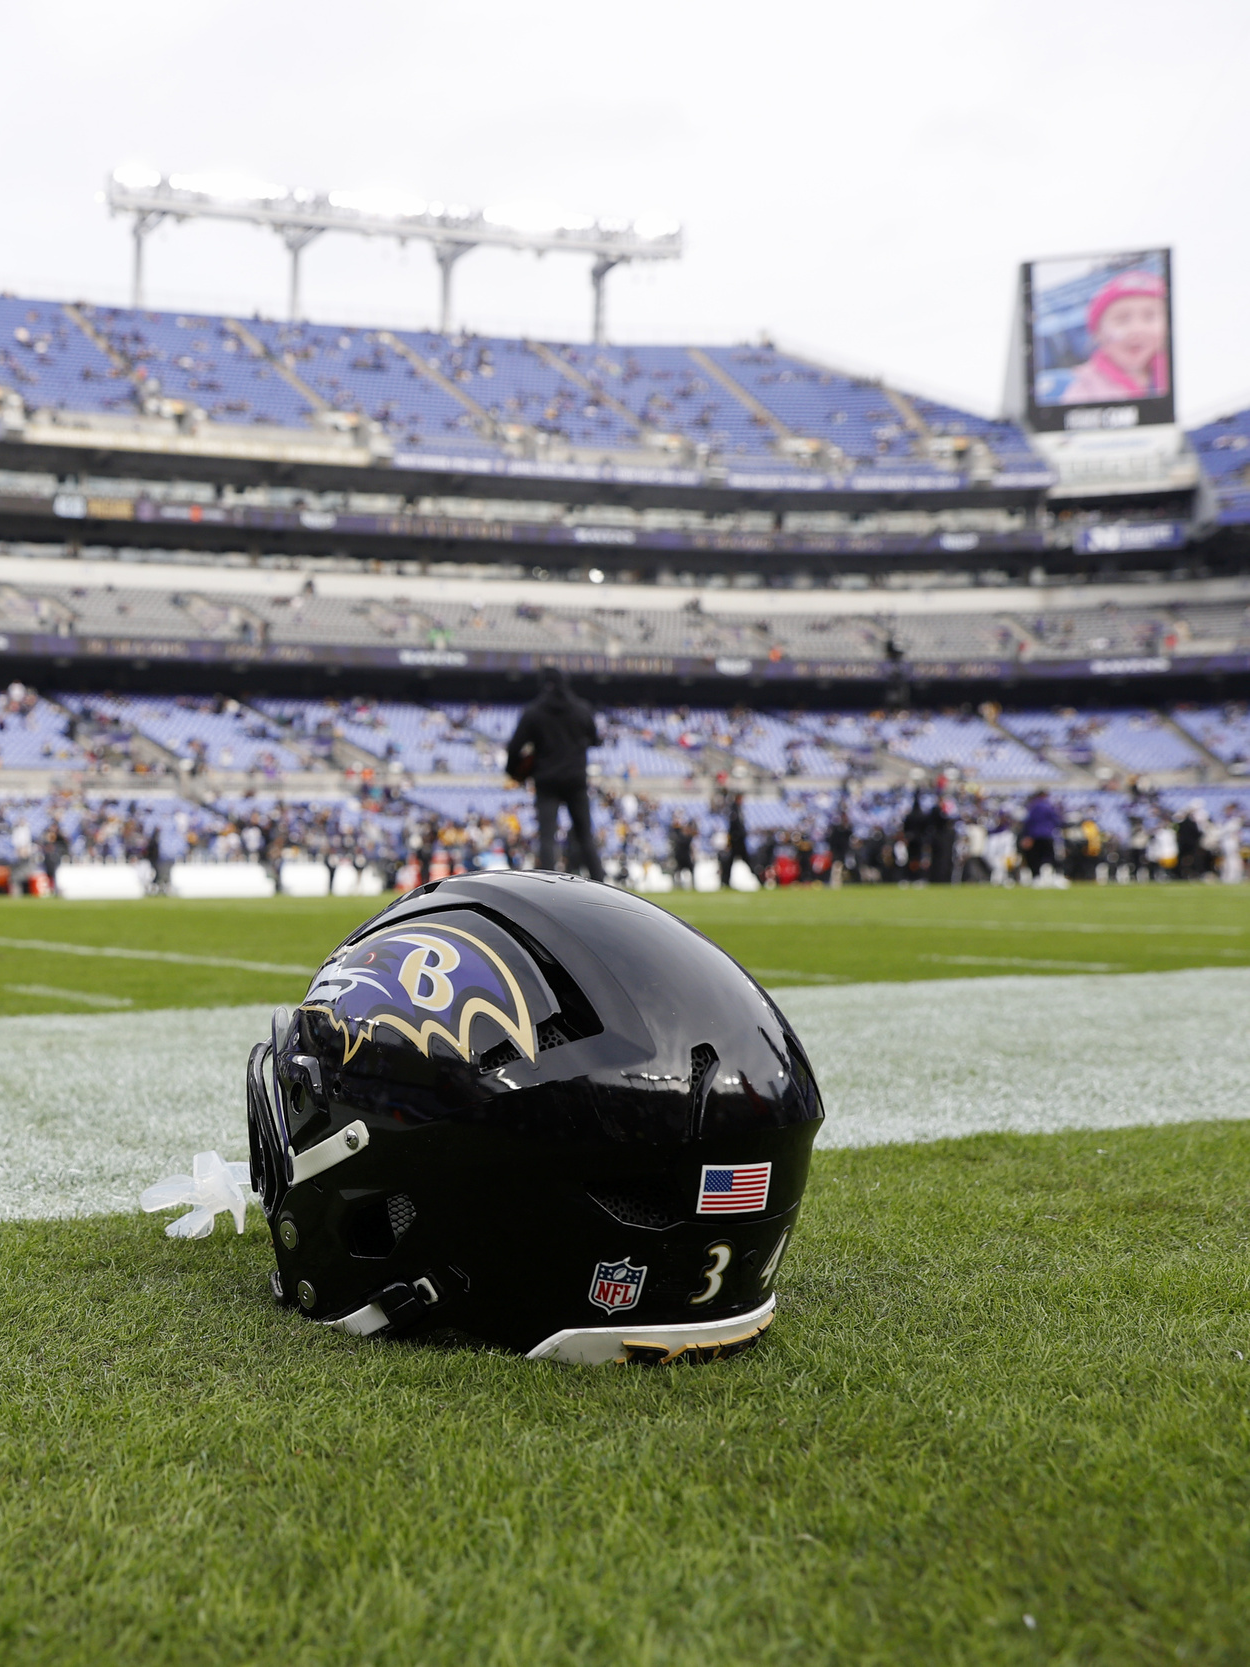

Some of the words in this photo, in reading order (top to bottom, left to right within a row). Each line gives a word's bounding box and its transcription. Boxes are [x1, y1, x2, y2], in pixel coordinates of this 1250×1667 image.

[383, 933, 461, 1012] B
[595, 1281, 633, 1306] NFL
[689, 1243, 733, 1304] 3
